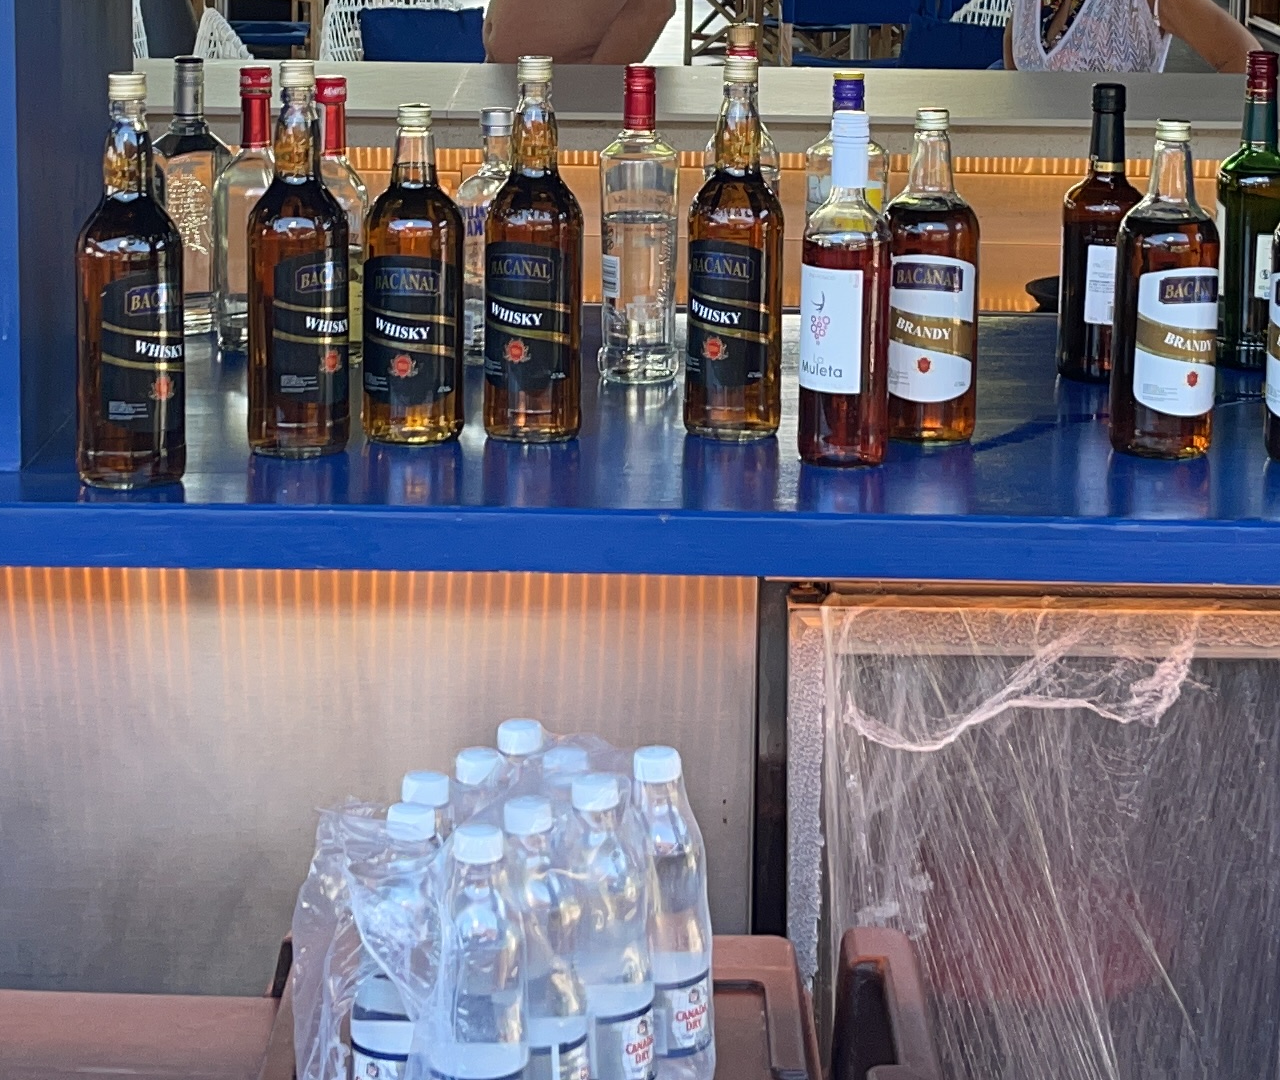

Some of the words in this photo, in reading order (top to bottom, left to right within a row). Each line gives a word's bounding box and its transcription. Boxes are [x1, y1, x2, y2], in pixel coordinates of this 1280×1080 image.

[490, 256, 551, 278] BACANAL
[896, 265, 961, 287] BACANAL
[375, 270, 439, 292] BACANAL
[490, 302, 543, 326] WHISKY
[692, 298, 742, 325] WHISKY
[305, 316, 349, 335] WHISKY
[375, 317, 431, 341] WHISKY
[896, 316, 952, 341] BRANDY
[135, 339, 183, 359] WHISKY
[1164, 331, 1214, 352] BRANDY
[801, 360, 843, 380] Muleta
[675, 1003, 707, 1020] CANADA
[686, 1019, 702, 1032] DRY
[635, 1050, 651, 1064] DRY
